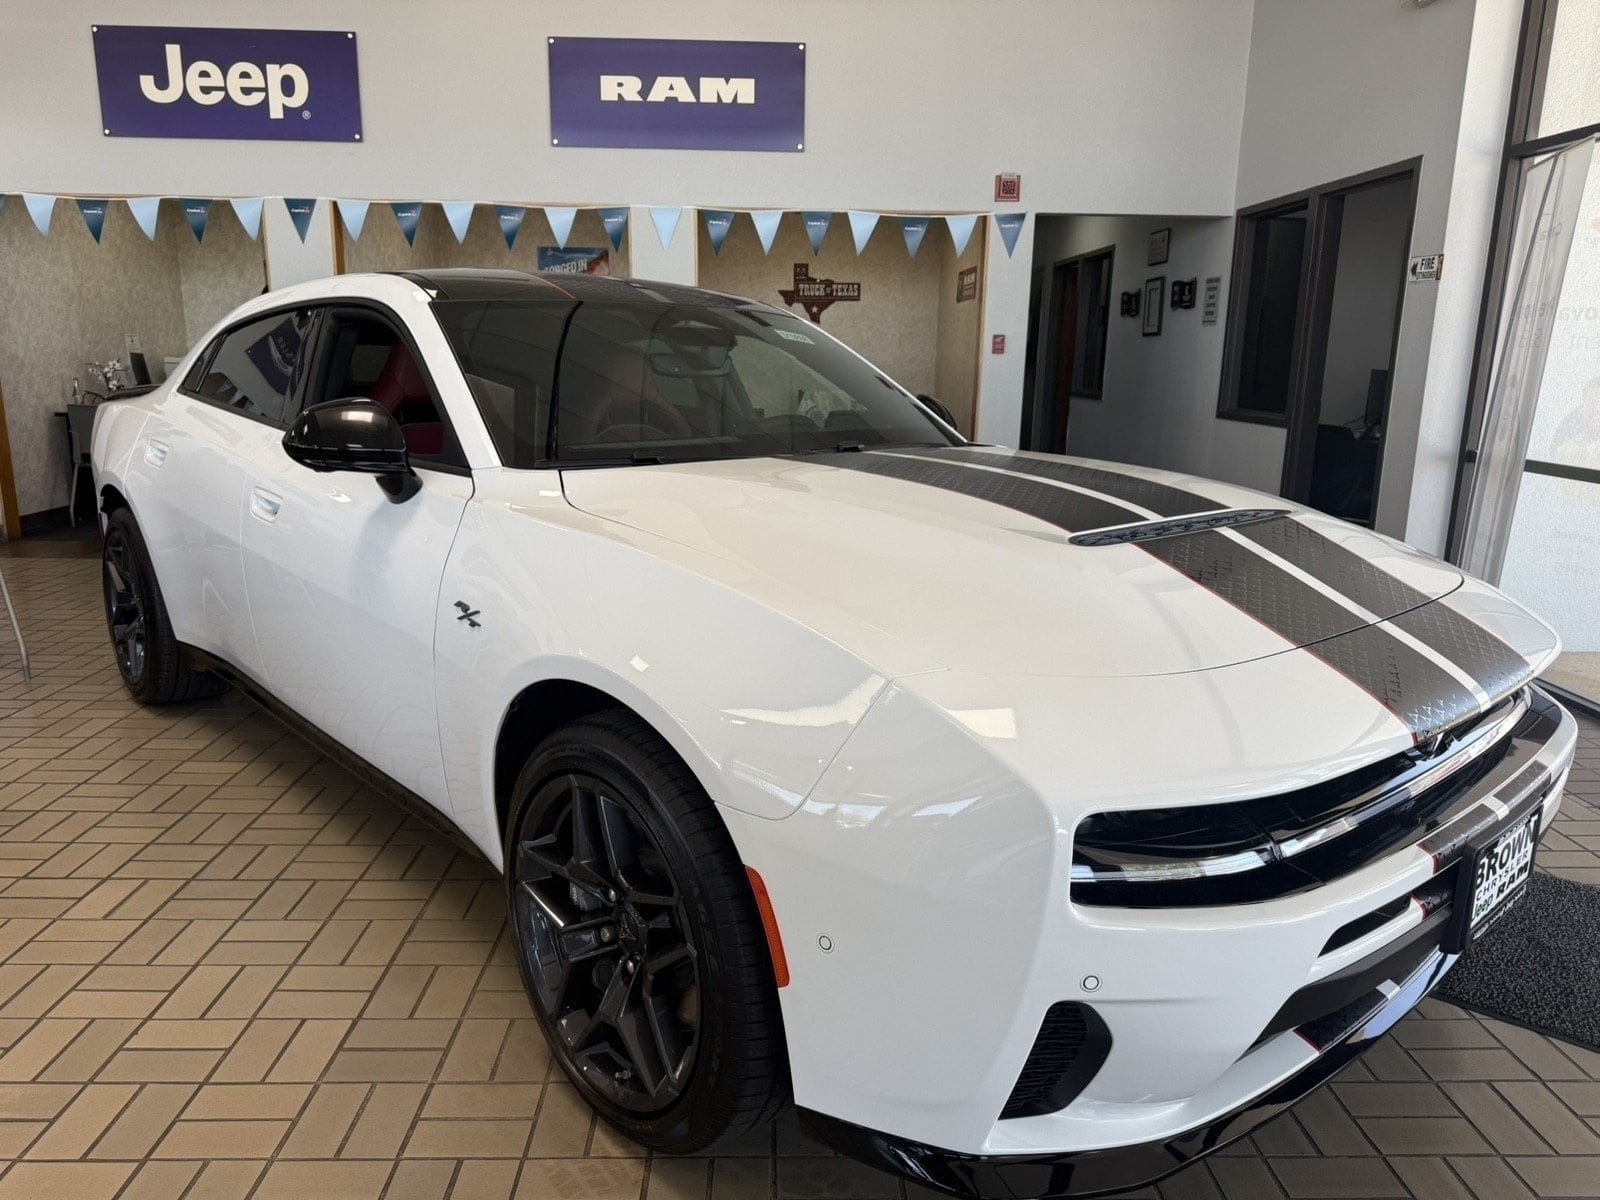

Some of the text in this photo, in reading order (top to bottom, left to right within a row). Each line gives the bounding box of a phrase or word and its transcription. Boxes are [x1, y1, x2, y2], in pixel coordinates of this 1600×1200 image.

[139, 43, 309, 119] Jeep
[599, 74, 755, 105] RAM
[578, 259, 588, 273] IN
[1420, 257, 1435, 270] FIRE
[798, 283, 826, 297] TRUCK
[832, 283, 859, 297] TEXAS
[1476, 816, 1538, 888] BROWN
[1473, 894, 1494, 920] Jeep
[1496, 861, 1529, 899] RAM
[1476, 850, 1529, 901] CHRYSLER
